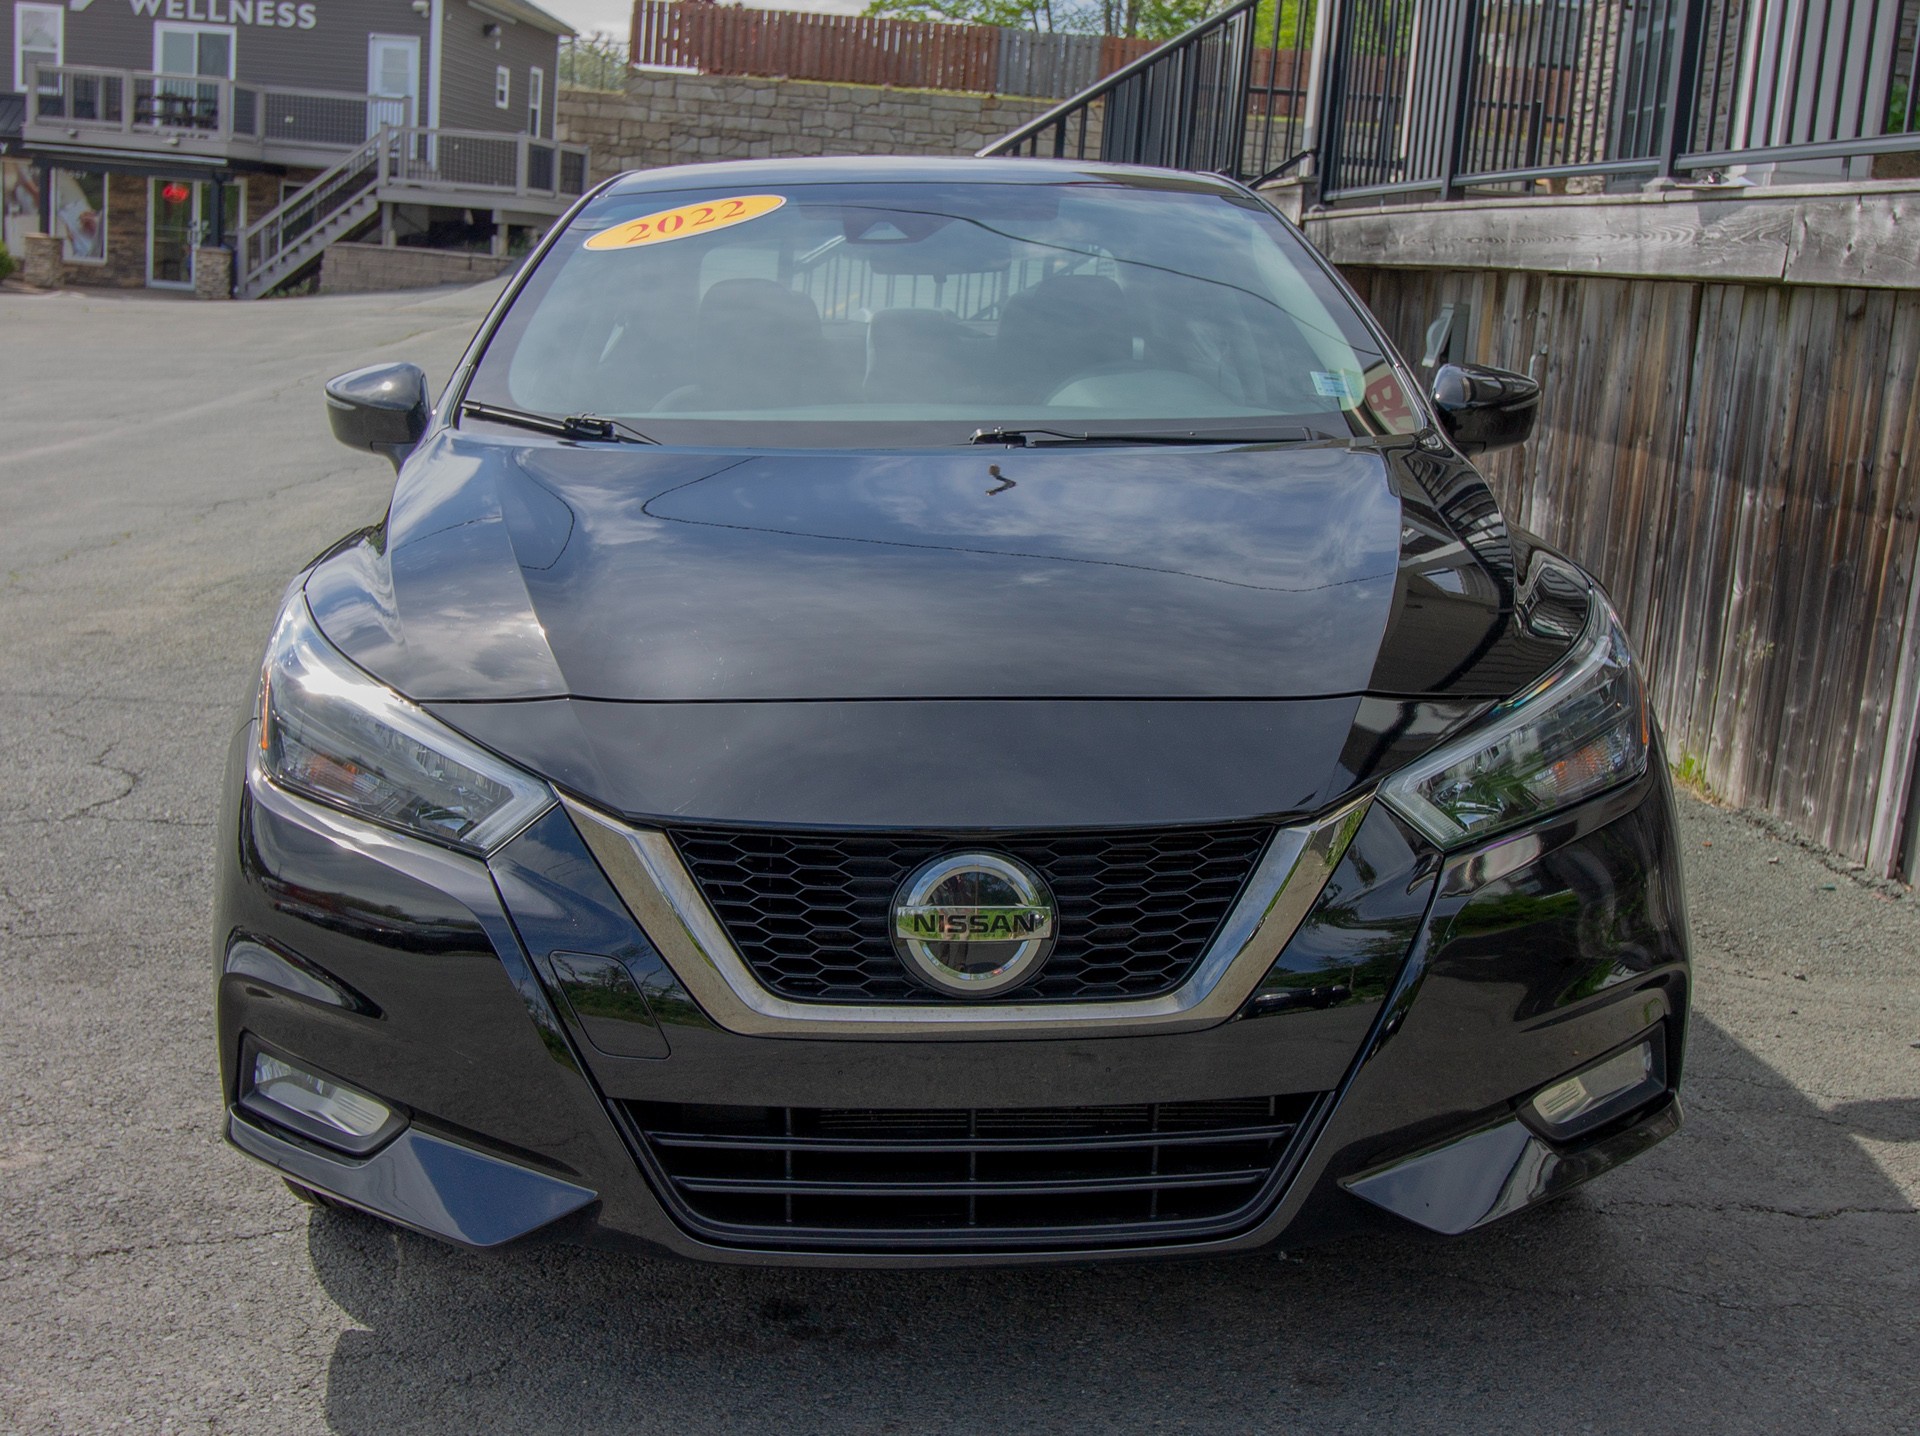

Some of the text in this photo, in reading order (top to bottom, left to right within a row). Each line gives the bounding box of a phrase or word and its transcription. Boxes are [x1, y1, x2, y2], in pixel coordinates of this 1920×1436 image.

[129, 0, 317, 29] WELLNESS
[625, 200, 746, 243] 2022
[913, 914, 1035, 933] NISSAN
